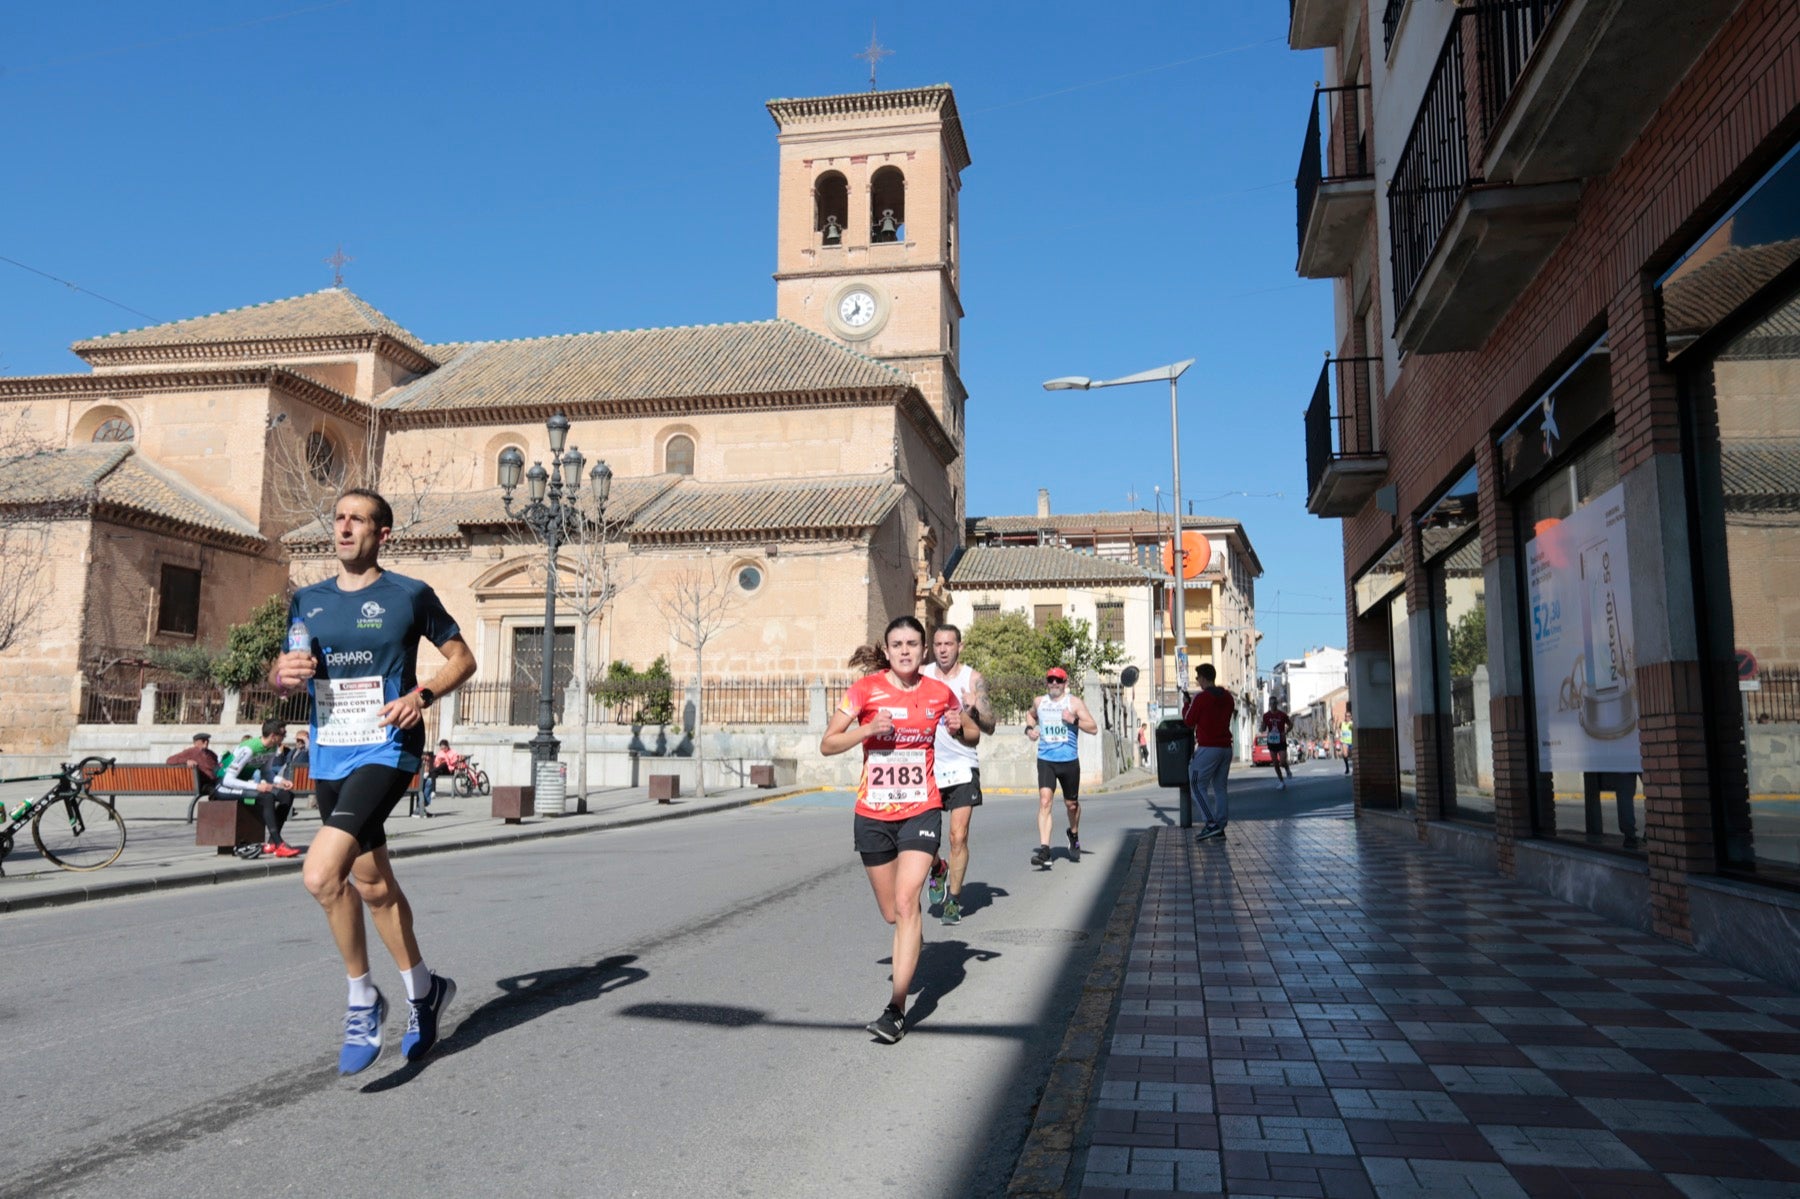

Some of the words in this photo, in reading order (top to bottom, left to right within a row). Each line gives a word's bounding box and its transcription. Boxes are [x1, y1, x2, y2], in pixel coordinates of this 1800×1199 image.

[1602, 552, 1611, 584] 5G
[1604, 591, 1618, 682] Note10+
[326, 650, 373, 663] DEHARO
[1045, 726, 1067, 735] 1106
[872, 766, 924, 786] 2183
[919, 829, 936, 838] FILA
